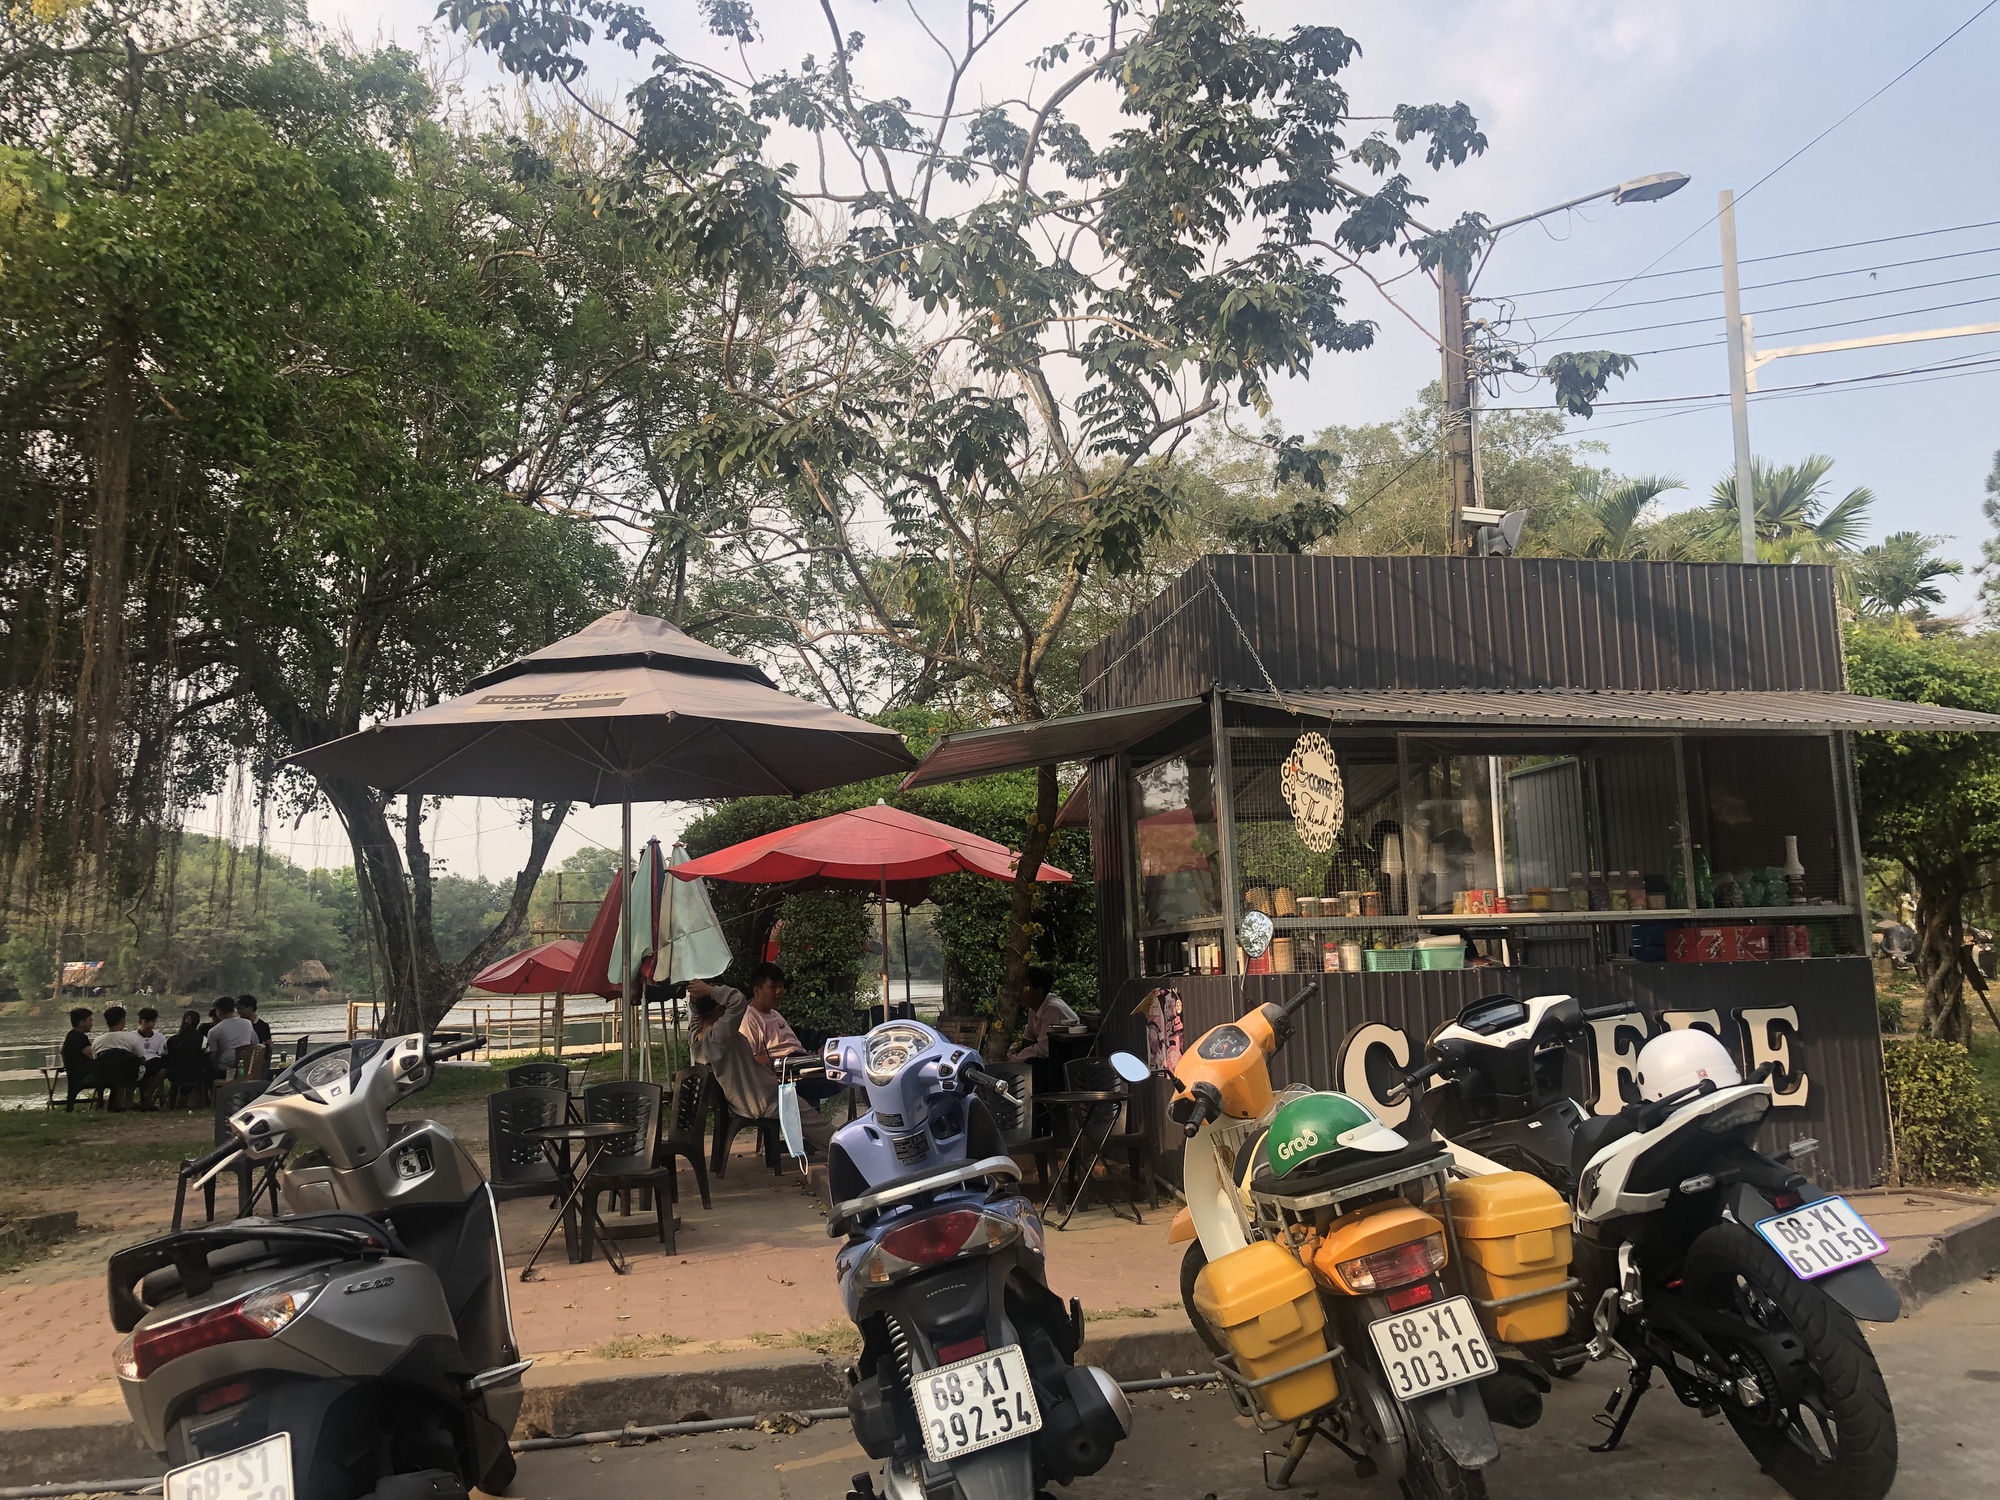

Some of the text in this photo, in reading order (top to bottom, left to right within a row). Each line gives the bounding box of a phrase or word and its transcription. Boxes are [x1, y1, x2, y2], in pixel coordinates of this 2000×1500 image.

[1308, 773, 1333, 800] COFFEE
[1337, 1003, 1809, 1131] CFE
[1277, 1128, 1319, 1160] Grab
[1774, 1204, 1847, 1245] 68-X1
[1788, 1227, 1878, 1274] 610.59
[926, 1282, 967, 1299] HONDA
[1388, 1305, 1462, 1353] 68-X1
[930, 1357, 1009, 1411] 68-X1
[1392, 1338, 1489, 1392] 303.16
[930, 1391, 1032, 1454] 392.54
